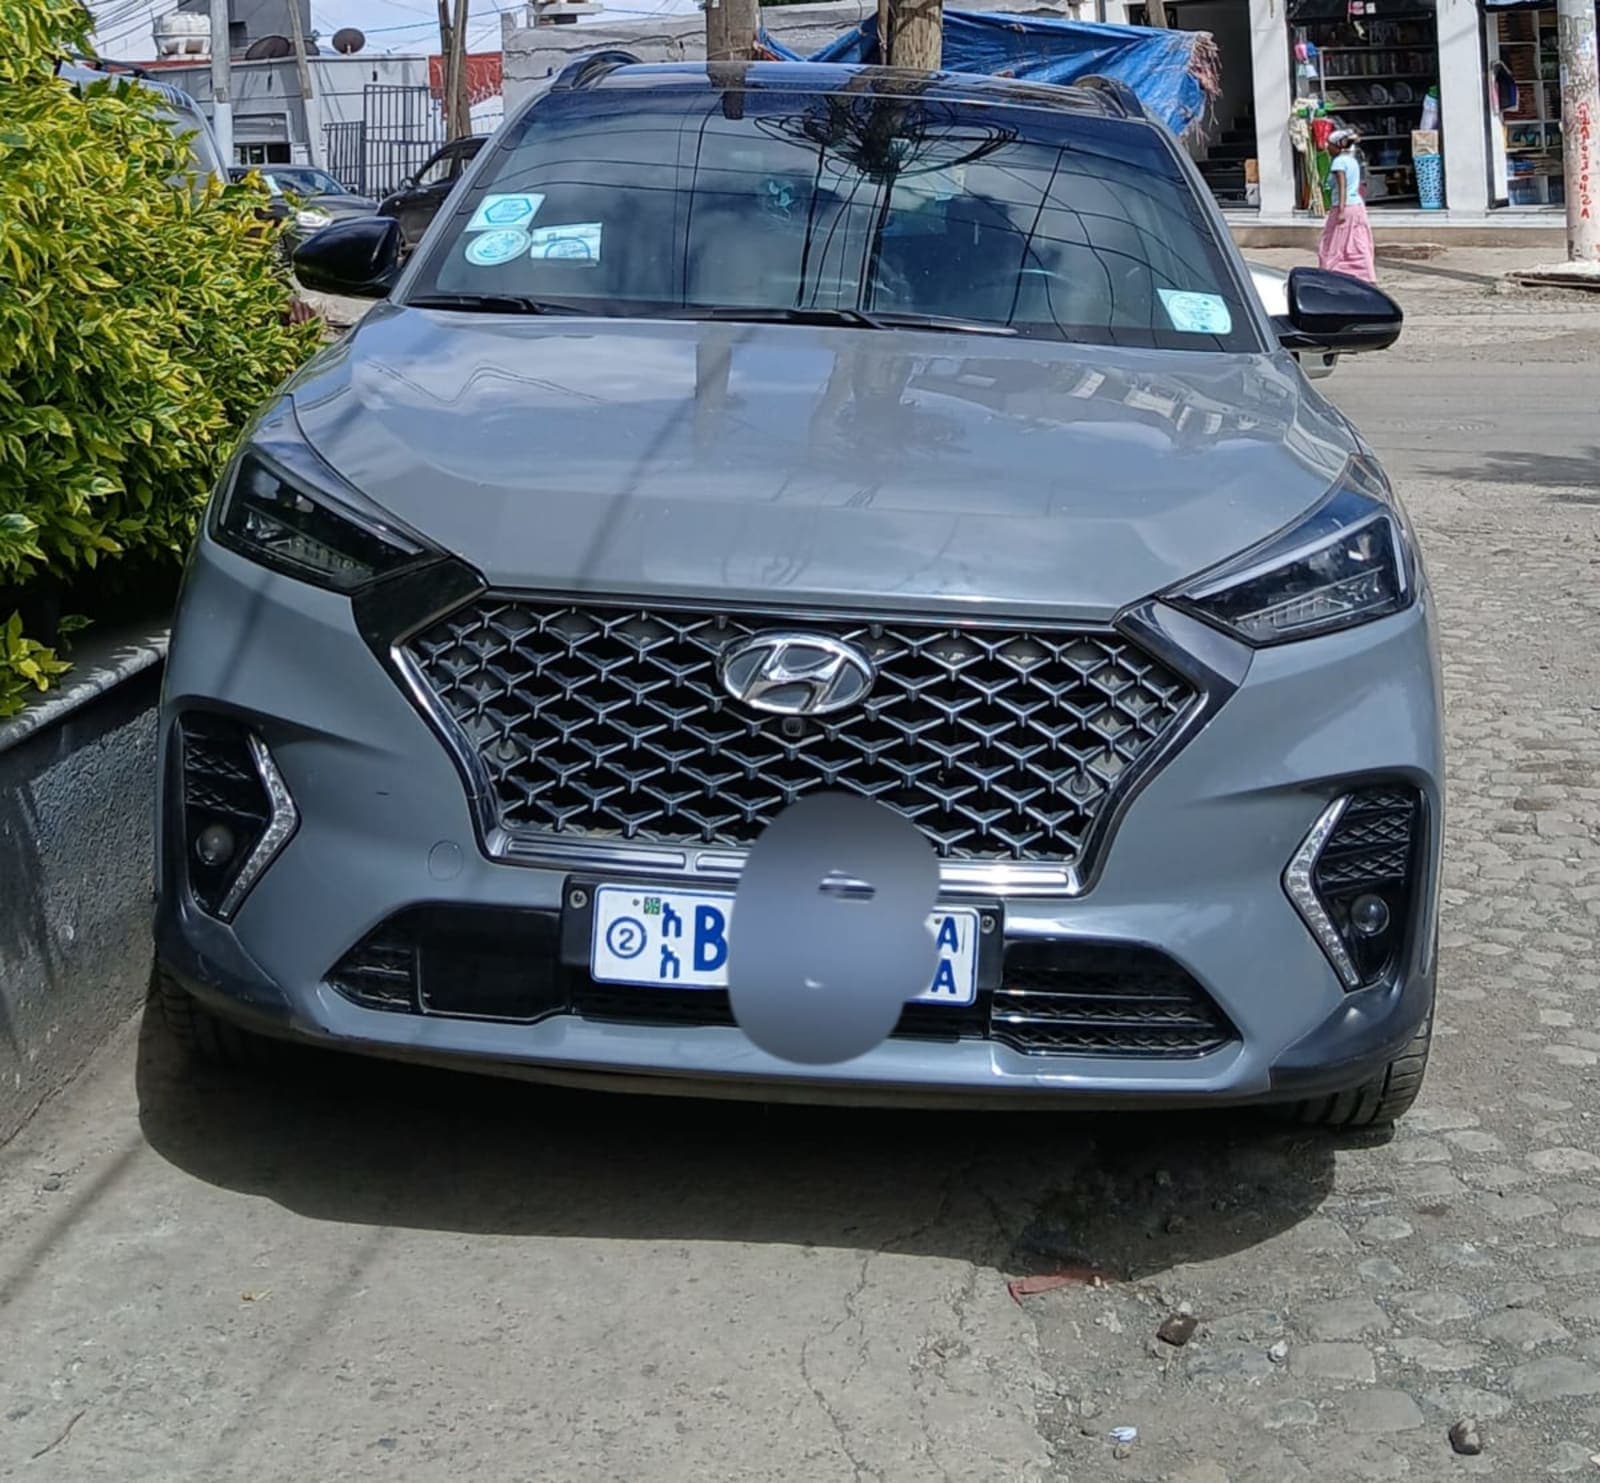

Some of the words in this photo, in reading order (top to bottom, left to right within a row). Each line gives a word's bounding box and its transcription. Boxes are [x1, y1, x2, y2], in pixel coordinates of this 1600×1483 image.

[618, 927, 635, 952] 2
[936, 916, 959, 953] A
[930, 959, 957, 995] A
